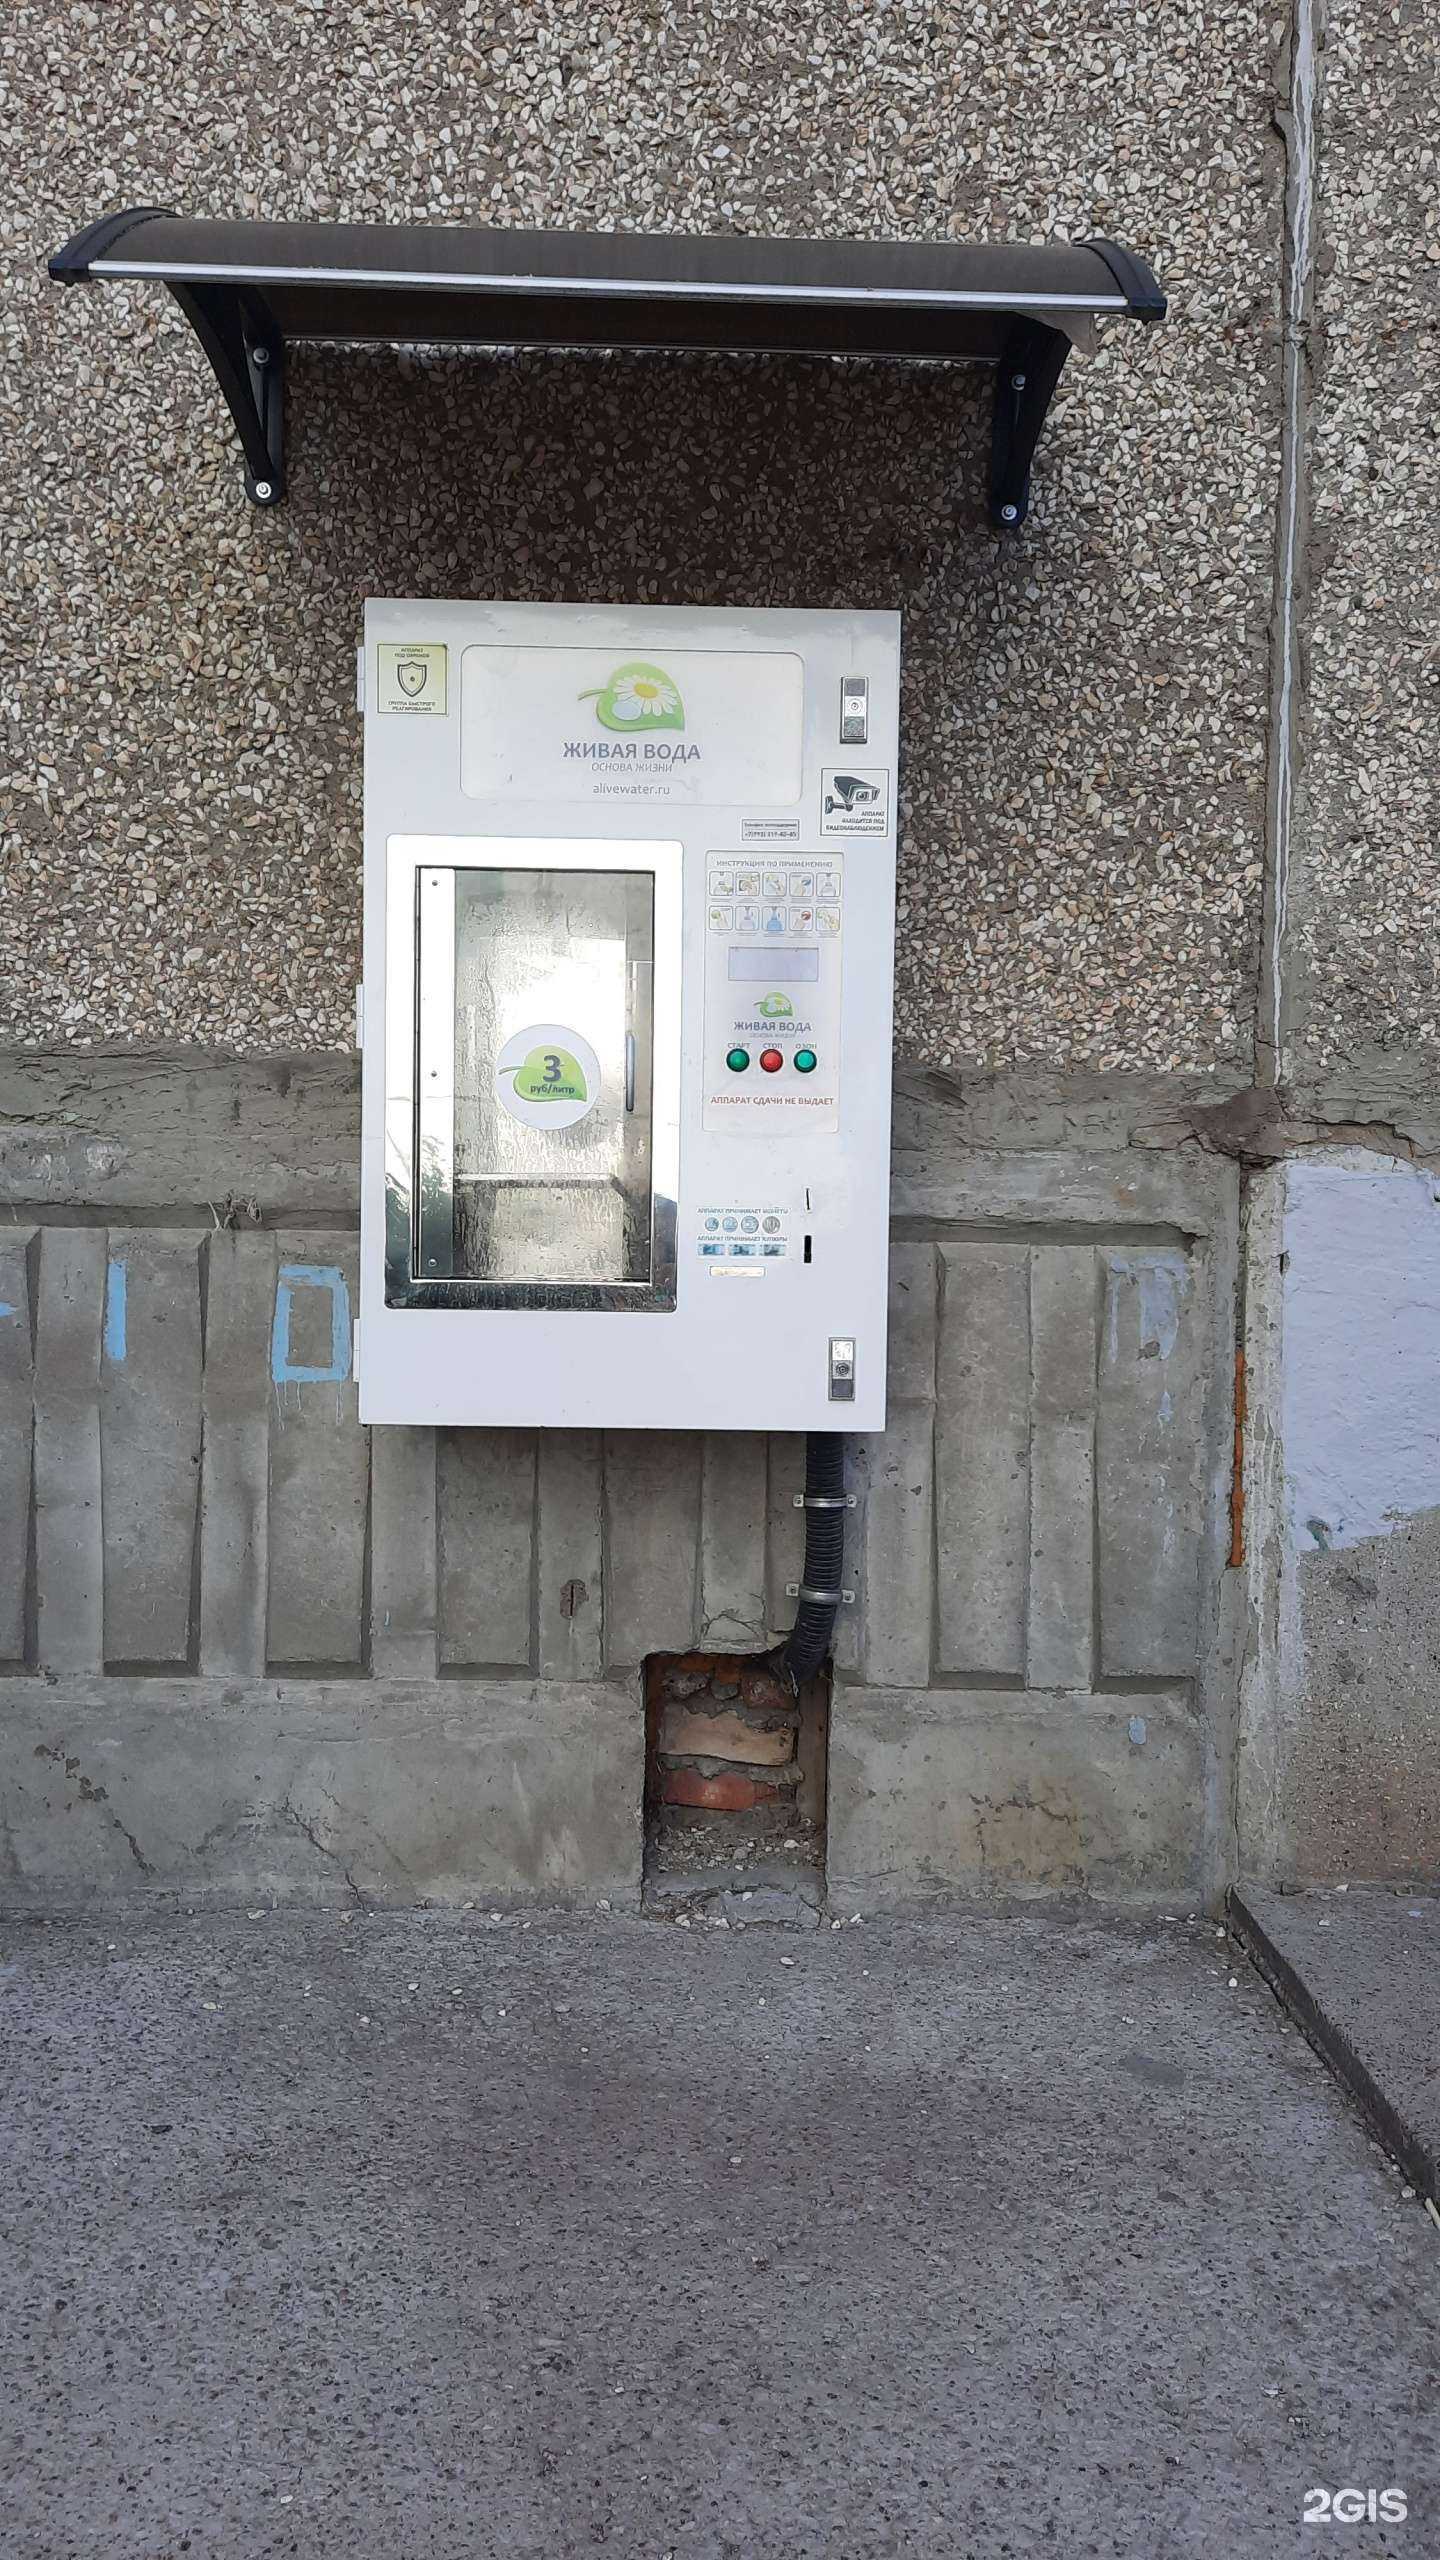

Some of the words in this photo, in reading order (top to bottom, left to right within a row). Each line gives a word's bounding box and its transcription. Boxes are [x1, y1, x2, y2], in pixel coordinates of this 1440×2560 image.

[563, 742, 637, 759] ЖИВАЯ
[644, 743, 701, 764] ВОДА
[591, 762, 633, 772] ОСНОВА
[635, 763, 673, 773] ЖИЗНИ
[592, 782, 671, 795] alivewater.ru
[716, 860, 765, 868] ИНСТРУКЦИЯ
[733, 1021, 776, 1031] ЖИВАЯ
[779, 1022, 812, 1033] ВОДА
[543, 1055, 562, 1082] 3
[530, 1084, 575, 1094] руб/литр
[710, 1096, 750, 1104] АППАРАТ
[753, 1097, 783, 1106] СДАЧИ
[799, 1098, 834, 1106] ВЫДАЕТ
